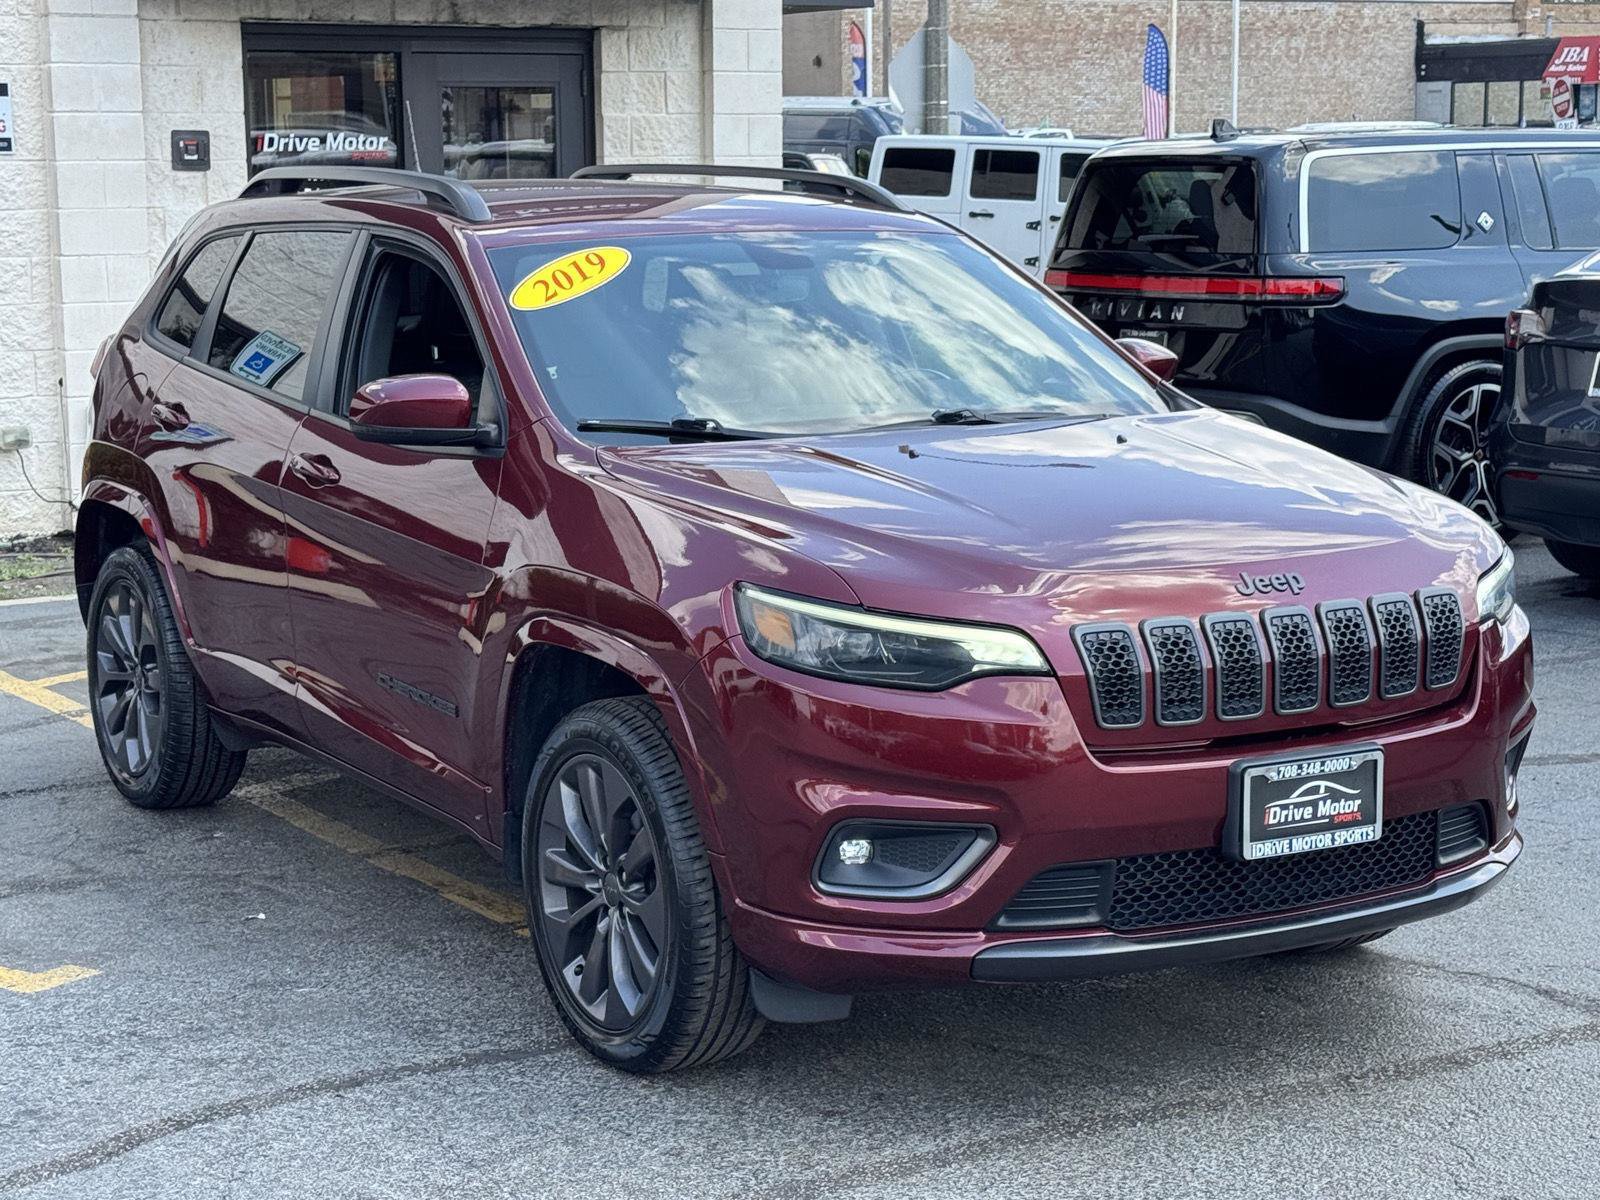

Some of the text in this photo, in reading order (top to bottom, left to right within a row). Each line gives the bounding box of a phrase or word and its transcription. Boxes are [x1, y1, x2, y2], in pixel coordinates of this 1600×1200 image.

[1555, 46, 1590, 64] JBA
[255, 131, 389, 152] iDrive Motor
[532, 252, 606, 303] 2019
[1091, 302, 1185, 321] RIVIAN
[1234, 570, 1306, 597] Jeep
[1278, 757, 1350, 779] 708-348-0000
[1264, 797, 1362, 826] iDrive Motor
[1333, 812, 1362, 824] SPORTS
[1292, 832, 1333, 853] MOTOR
[1334, 826, 1375, 846] SPORTS
